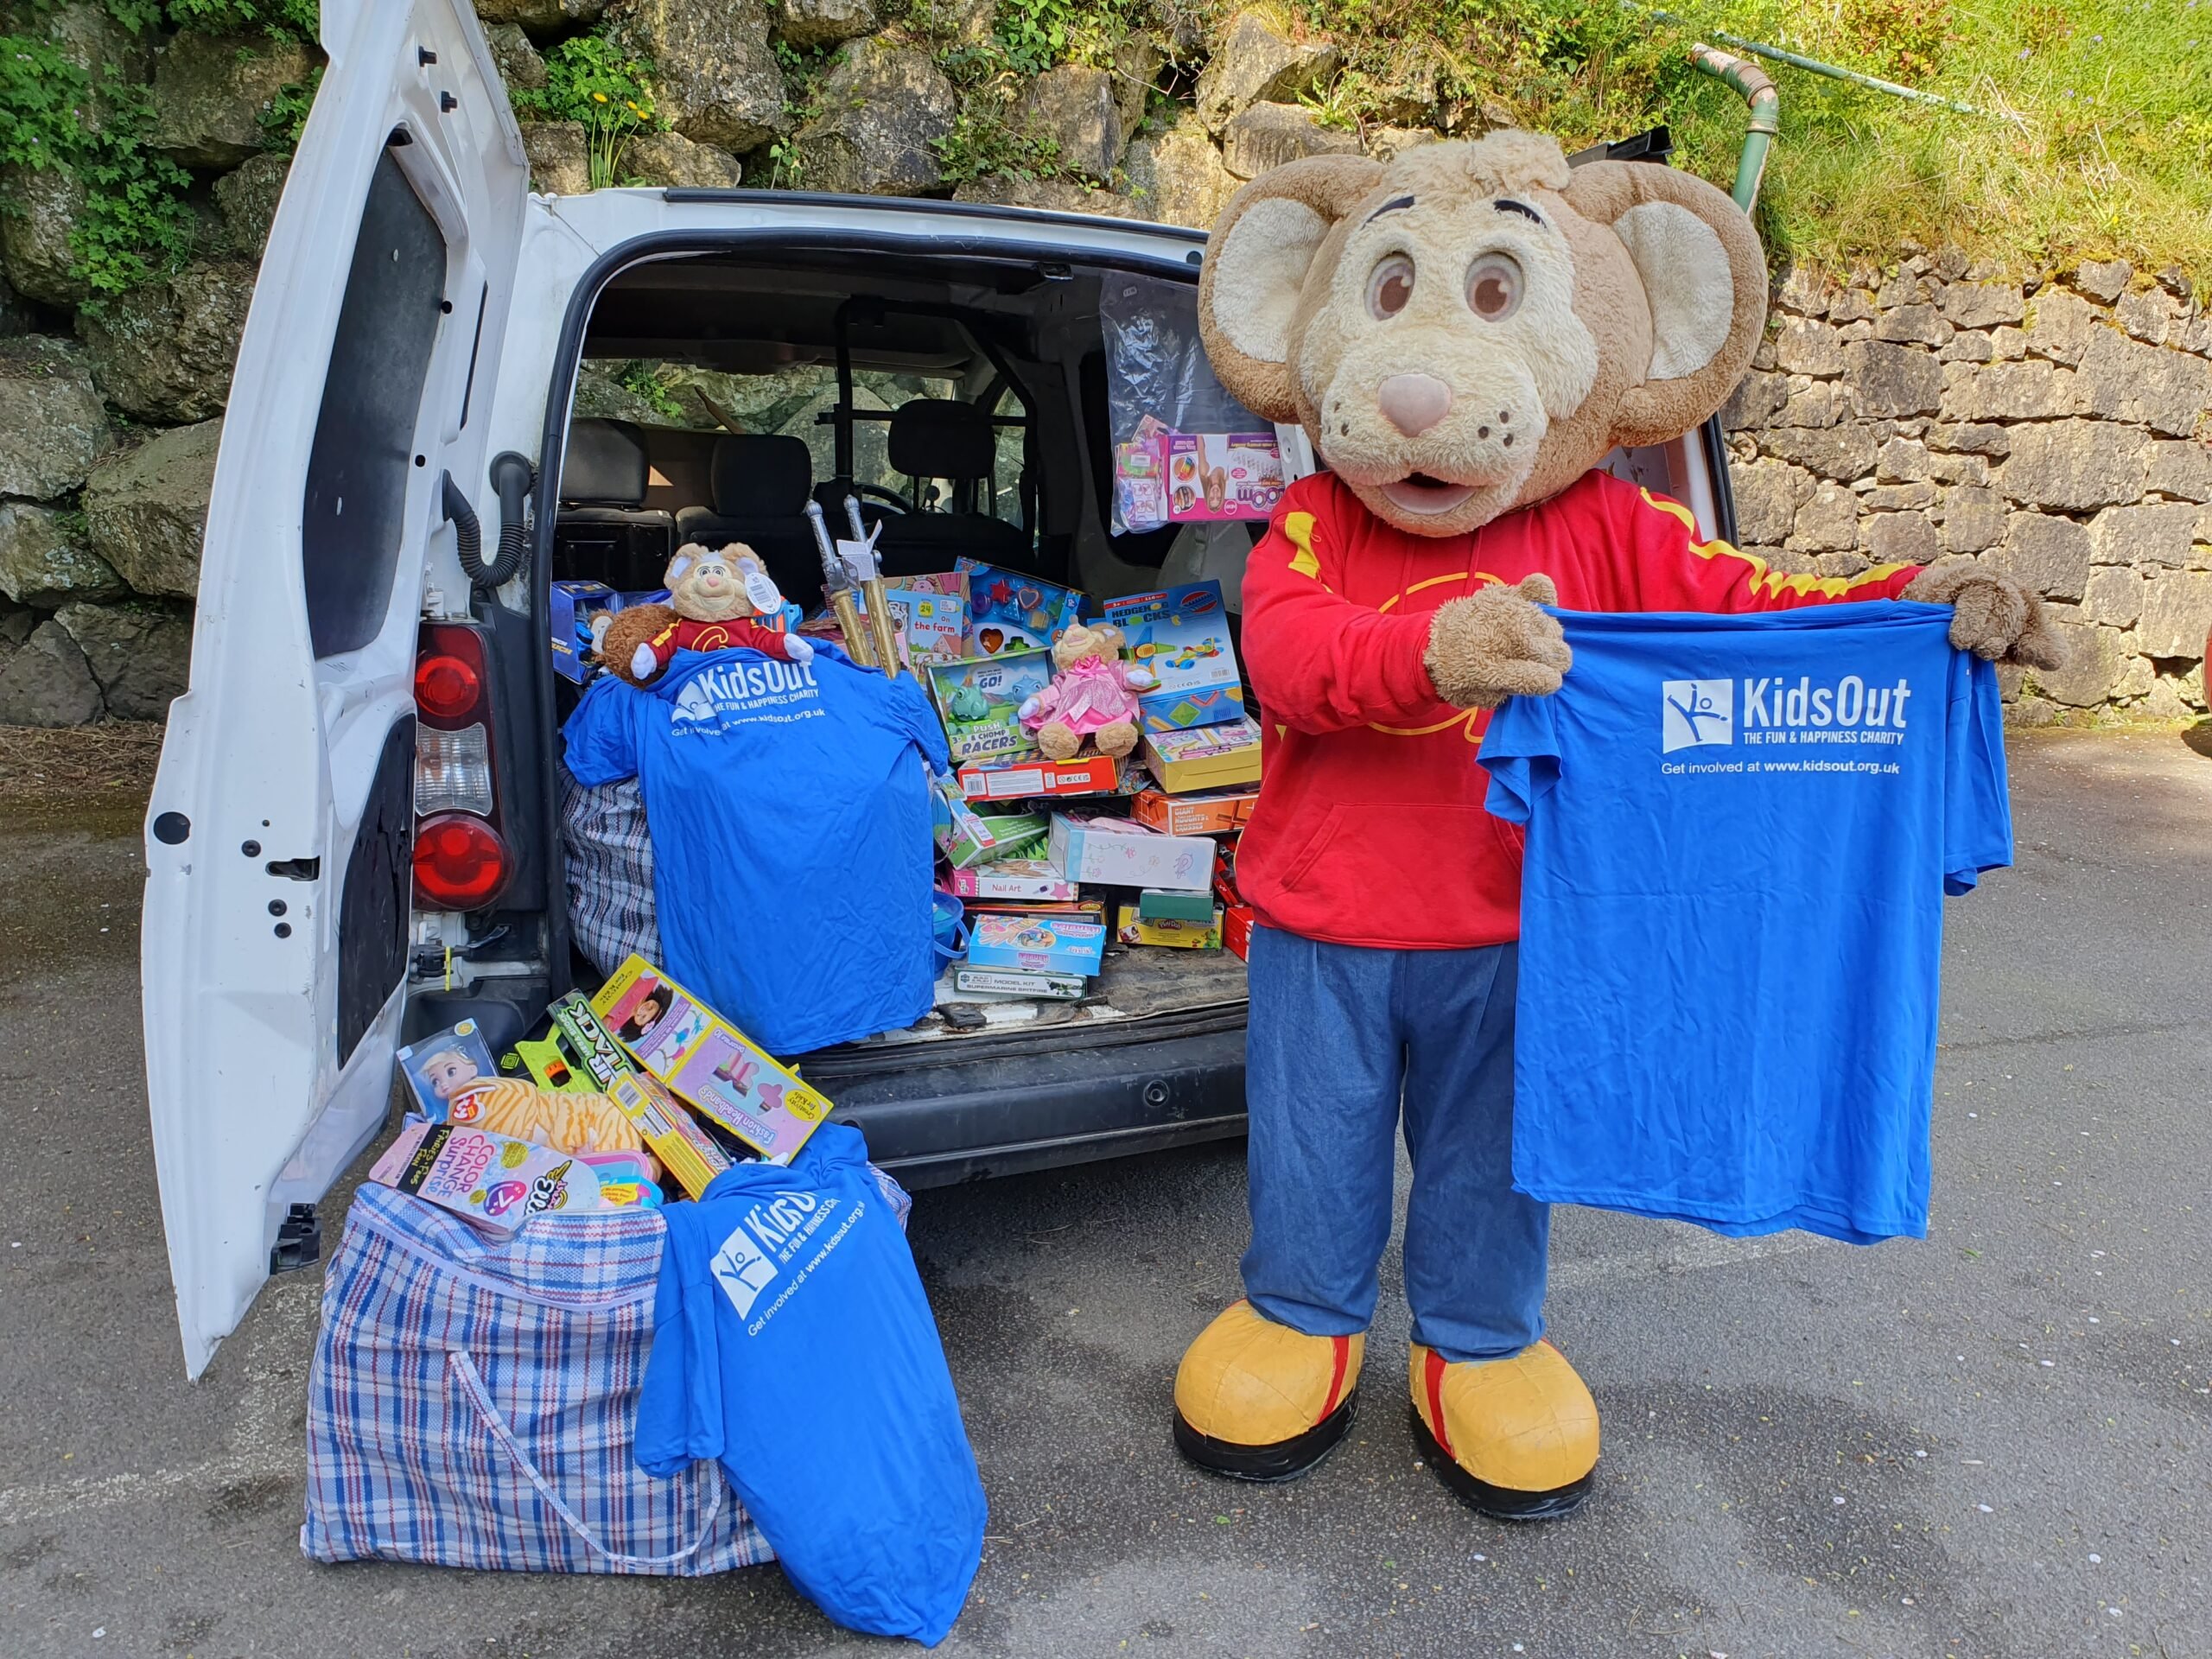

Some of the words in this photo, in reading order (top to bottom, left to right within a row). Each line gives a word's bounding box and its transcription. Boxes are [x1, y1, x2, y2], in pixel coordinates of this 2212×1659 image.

[933, 623, 955, 632] farm
[697, 660, 817, 702] KidsOut
[979, 676, 1002, 689] GO!
[715, 702, 725, 712] HE
[726, 702, 740, 711] FUN
[741, 702, 747, 710] &
[749, 696, 788, 709] HAPPINESS
[790, 689, 819, 703] CHARITY
[1744, 676, 1911, 728] KidsOut
[722, 721, 732, 731] at
[973, 722, 1001, 733] PUSH
[978, 730, 1006, 739] CHOMP
[962, 735, 1017, 755] RACERS
[1744, 732, 1763, 745] THE
[1765, 732, 1786, 744] FUN
[1789, 732, 1796, 743] &
[1800, 731, 1857, 744] HAPPINESS
[1859, 732, 1904, 746] CHARITY
[1661, 763, 1685, 774] Get
[1688, 762, 1743, 773] involved
[1747, 762, 1760, 772] at
[1764, 760, 1900, 775] www.kidsout.org.uk
[569, 1001, 628, 1078] TTACK
[454, 1098, 471, 1119] ty
[701, 1087, 744, 1124] Headbands
[788, 1097, 815, 1120] Creativity
[794, 1090, 808, 1104] Kids
[804, 1100, 816, 1111] for
[742, 1115, 774, 1143] Fashion
[426, 1137, 467, 1196] Surprise
[438, 1135, 485, 1198] CHANGE
[458, 1145, 495, 1192] COLOR
[779, 1249, 792, 1264] THE
[800, 1232, 807, 1243] &
[748, 1317, 766, 1337] Get
[765, 1281, 798, 1320] involved
[798, 1270, 807, 1284] at
